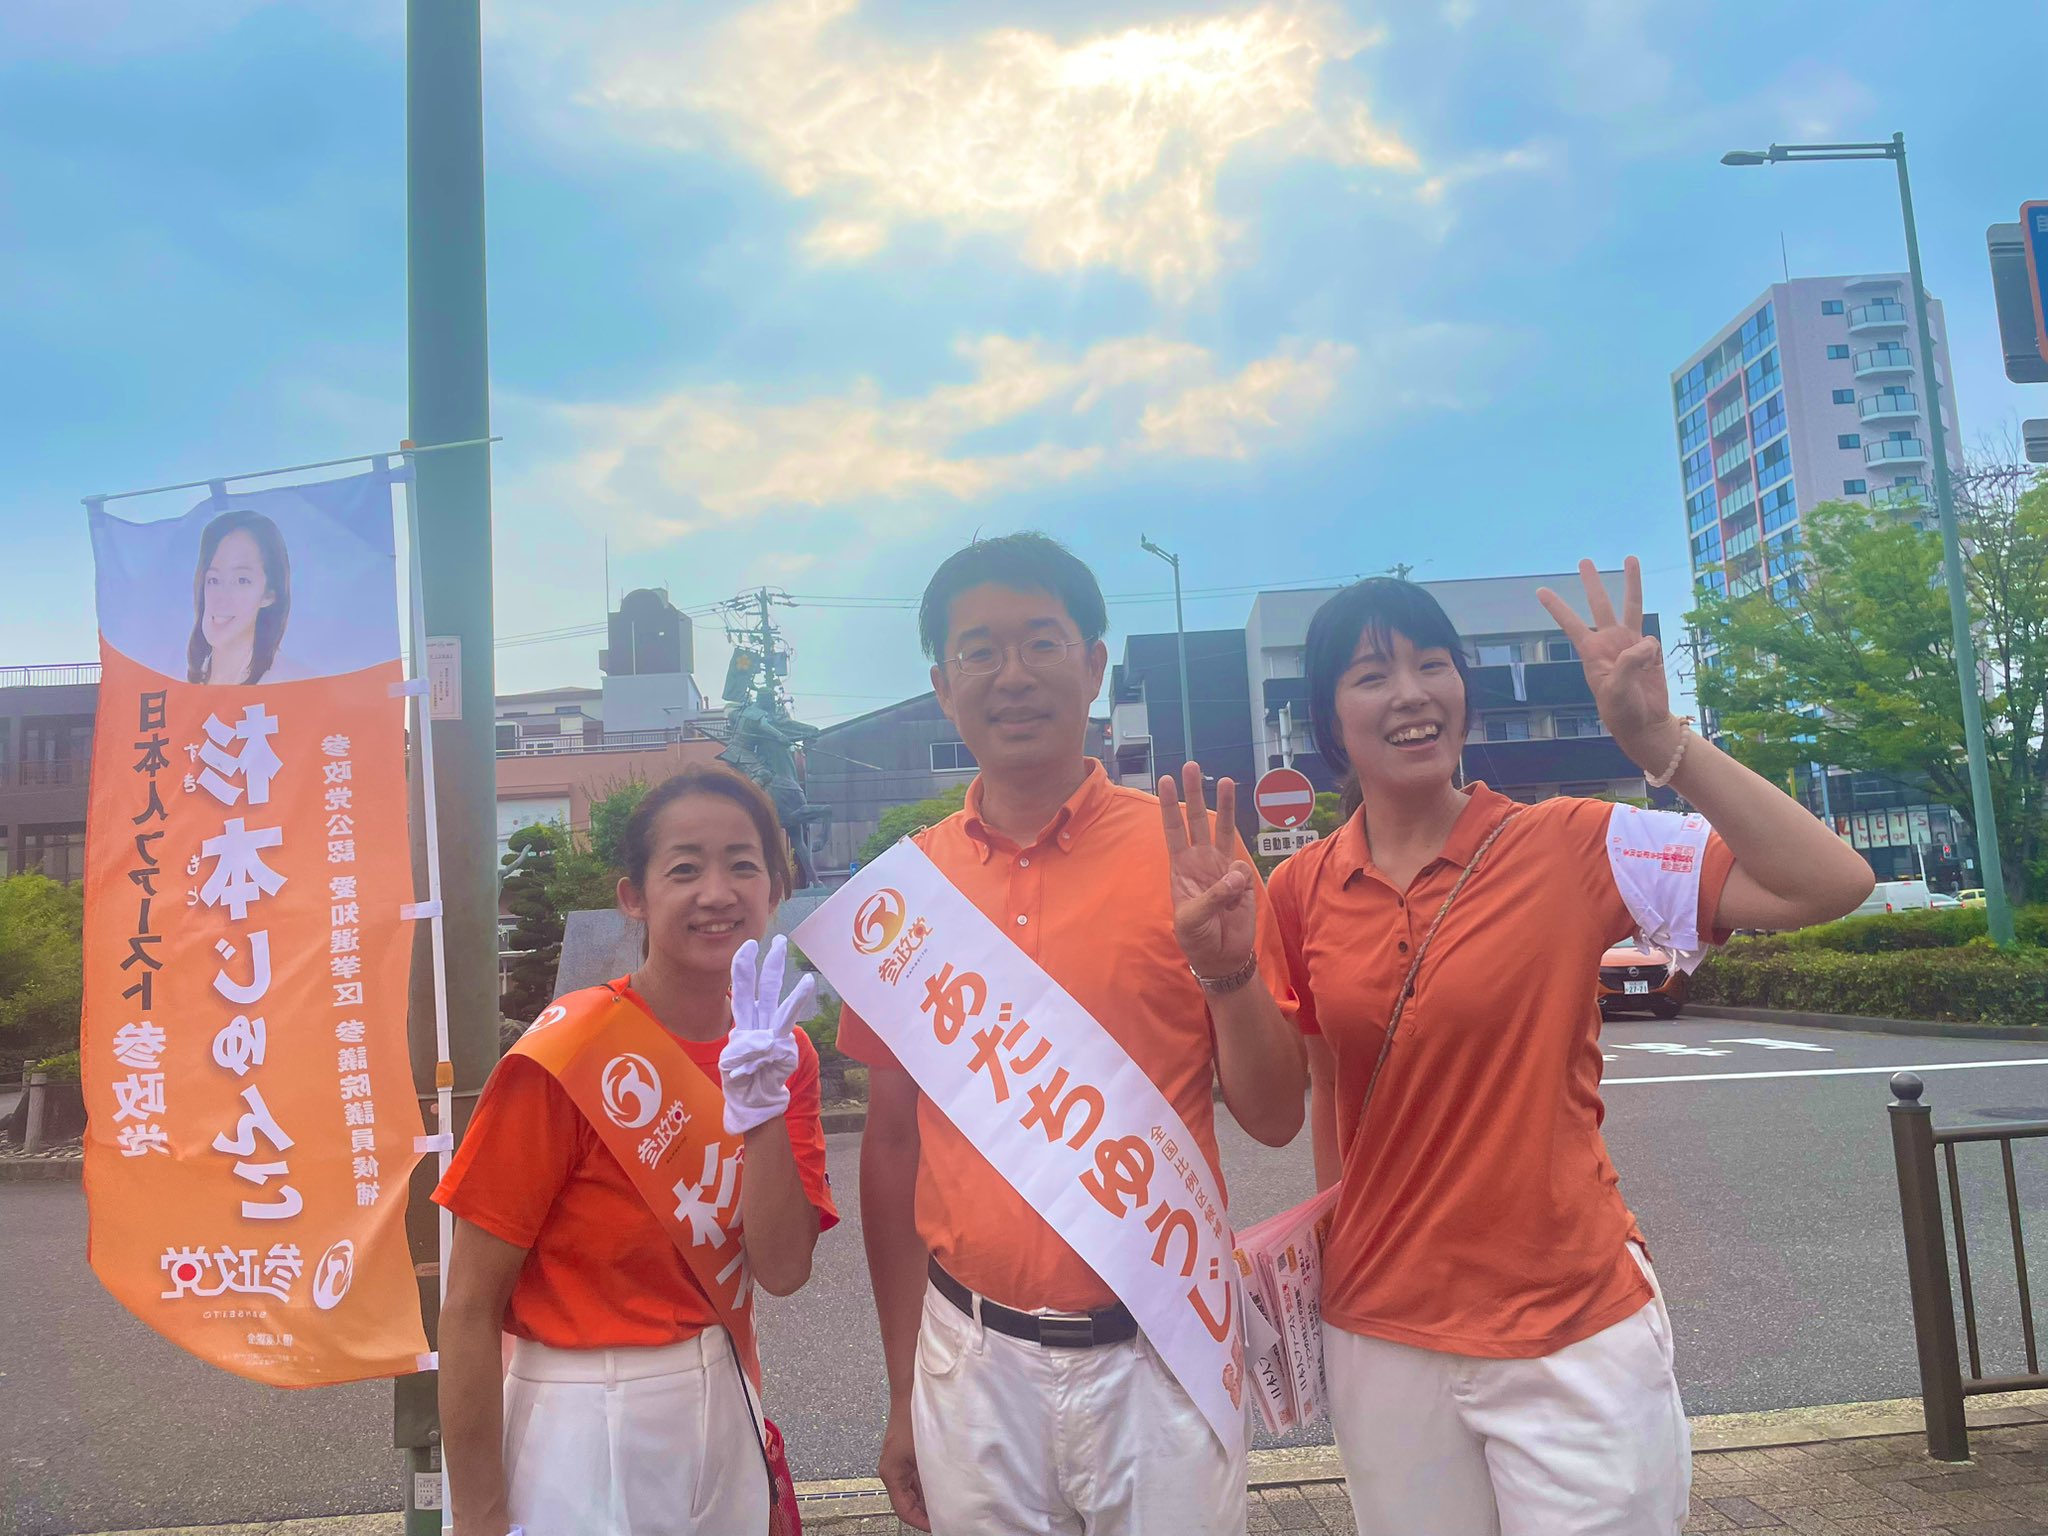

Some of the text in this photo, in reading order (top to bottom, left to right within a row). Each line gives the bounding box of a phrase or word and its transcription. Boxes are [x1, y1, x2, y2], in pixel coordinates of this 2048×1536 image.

[879, 916, 933, 986] 参政党
[637, 1100, 692, 1170] 参政党
[920, 962, 1232, 1344] あだちゆうじ
